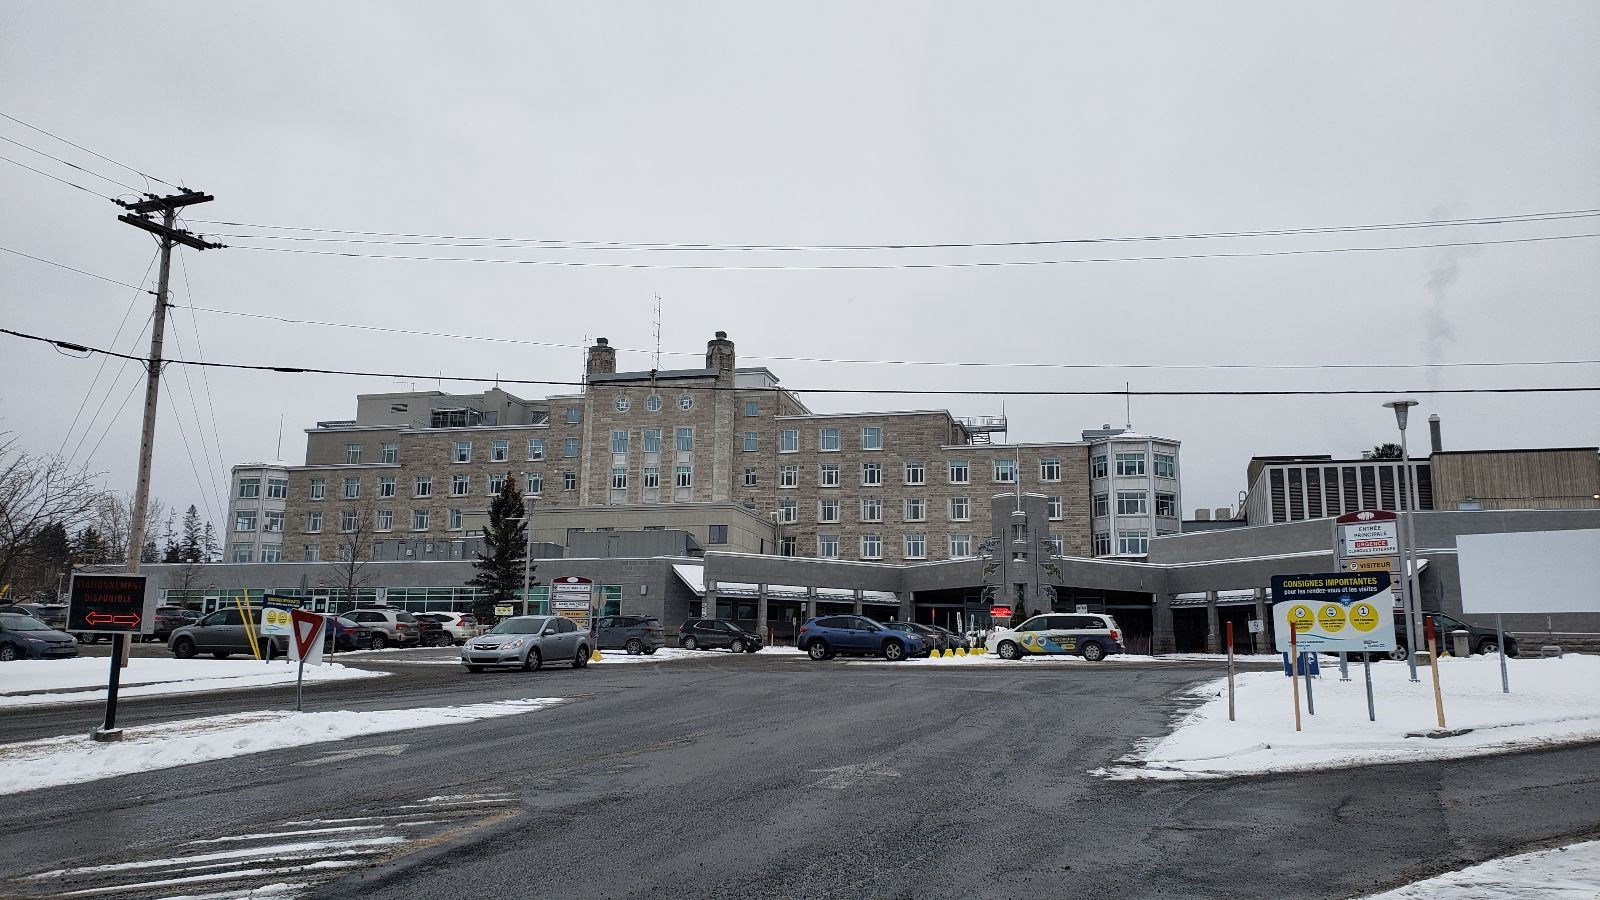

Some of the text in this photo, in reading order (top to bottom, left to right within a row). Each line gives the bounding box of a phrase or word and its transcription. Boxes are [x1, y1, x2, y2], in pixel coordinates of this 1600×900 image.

[1359, 561, 1391, 569] VISITEUR
[76, 580, 143, 590] STATIONNEMENT
[1283, 577, 1378, 588] CONSIGNES IMPORTANTES
[84, 593, 133, 603] DISPONIBLE
